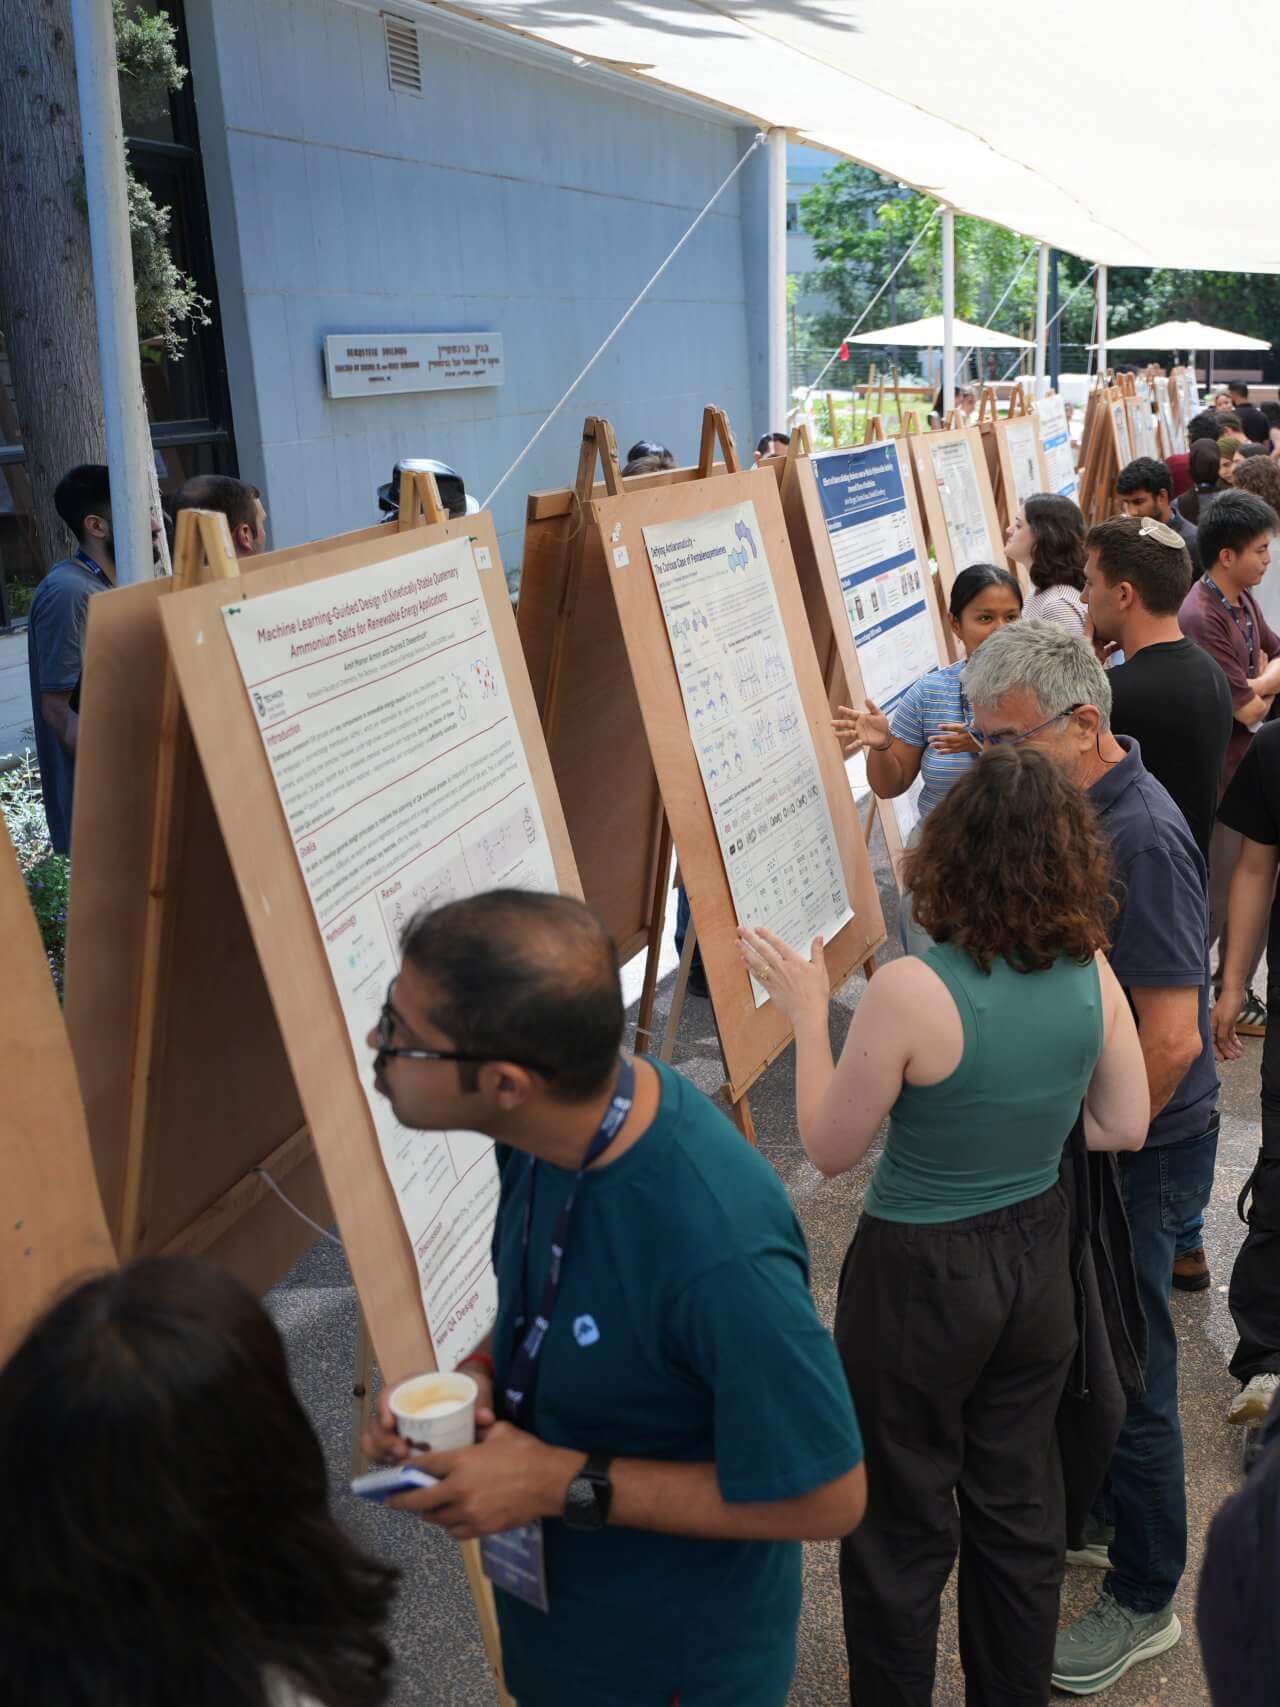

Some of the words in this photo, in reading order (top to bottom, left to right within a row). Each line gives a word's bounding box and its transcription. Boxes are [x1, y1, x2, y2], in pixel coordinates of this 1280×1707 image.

[256, 620, 297, 644] Machine
[297, 599, 360, 628] Learning-Guided
[359, 592, 384, 611] Design
[388, 578, 419, 601] Kinetically
[416, 573, 434, 592] Stable
[433, 566, 460, 586] Quaternary
[290, 632, 337, 658] Ammonium
[337, 623, 356, 642] Salts
[355, 620, 368, 636] for
[367, 606, 401, 632] Renewable
[400, 600, 419, 619] Energy
[419, 590, 449, 614] Applications
[267, 724, 301, 746] Introduction
[381, 880, 402, 899] Results
[455, 1291, 480, 1322] Designs
